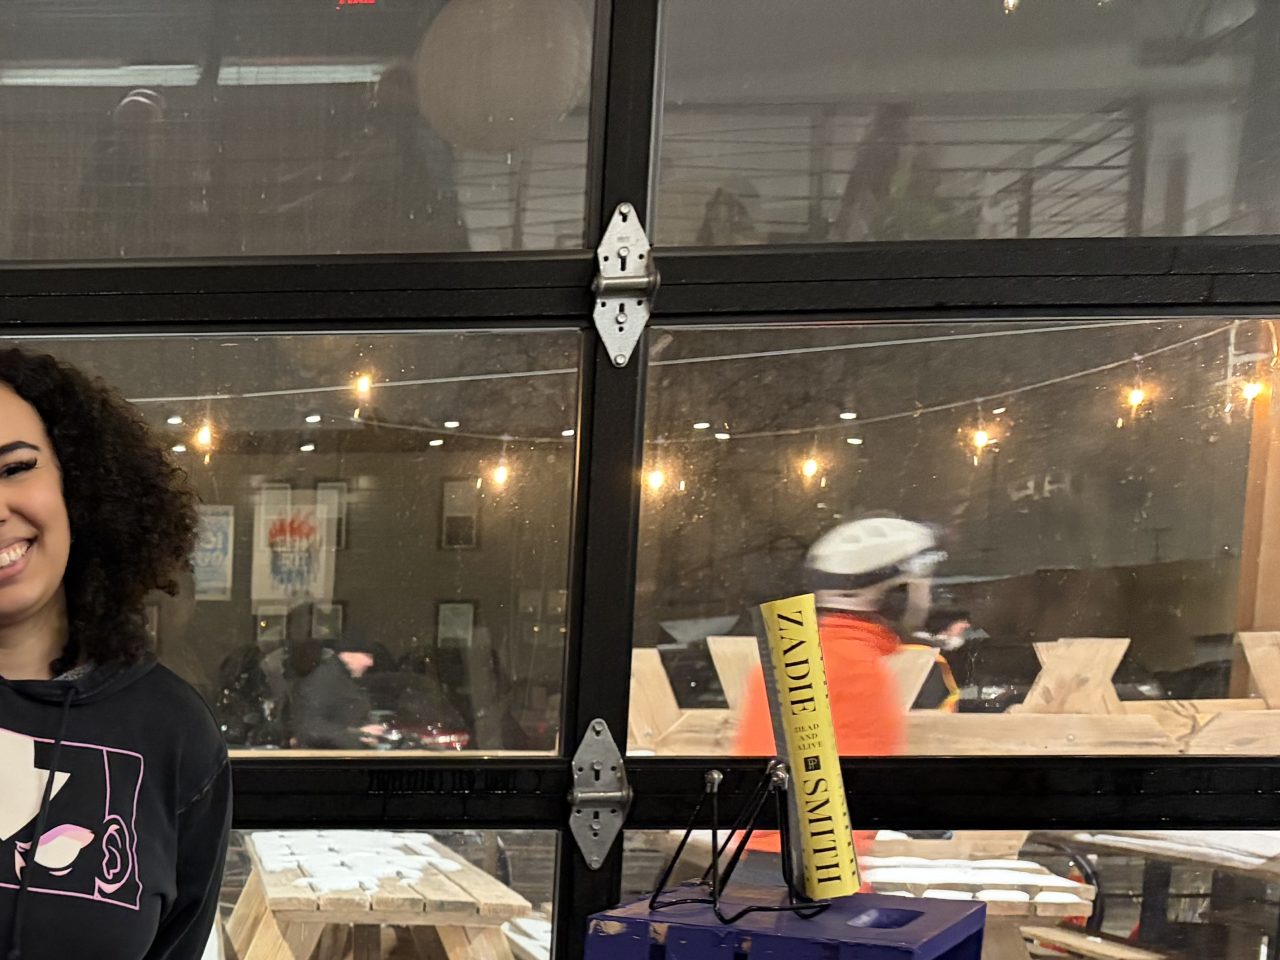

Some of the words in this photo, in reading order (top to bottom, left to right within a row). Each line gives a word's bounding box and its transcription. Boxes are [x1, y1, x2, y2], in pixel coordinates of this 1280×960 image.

[776, 610, 817, 716] ZADIE
[799, 732, 818, 742] AND
[803, 778, 842, 885] SMITH
